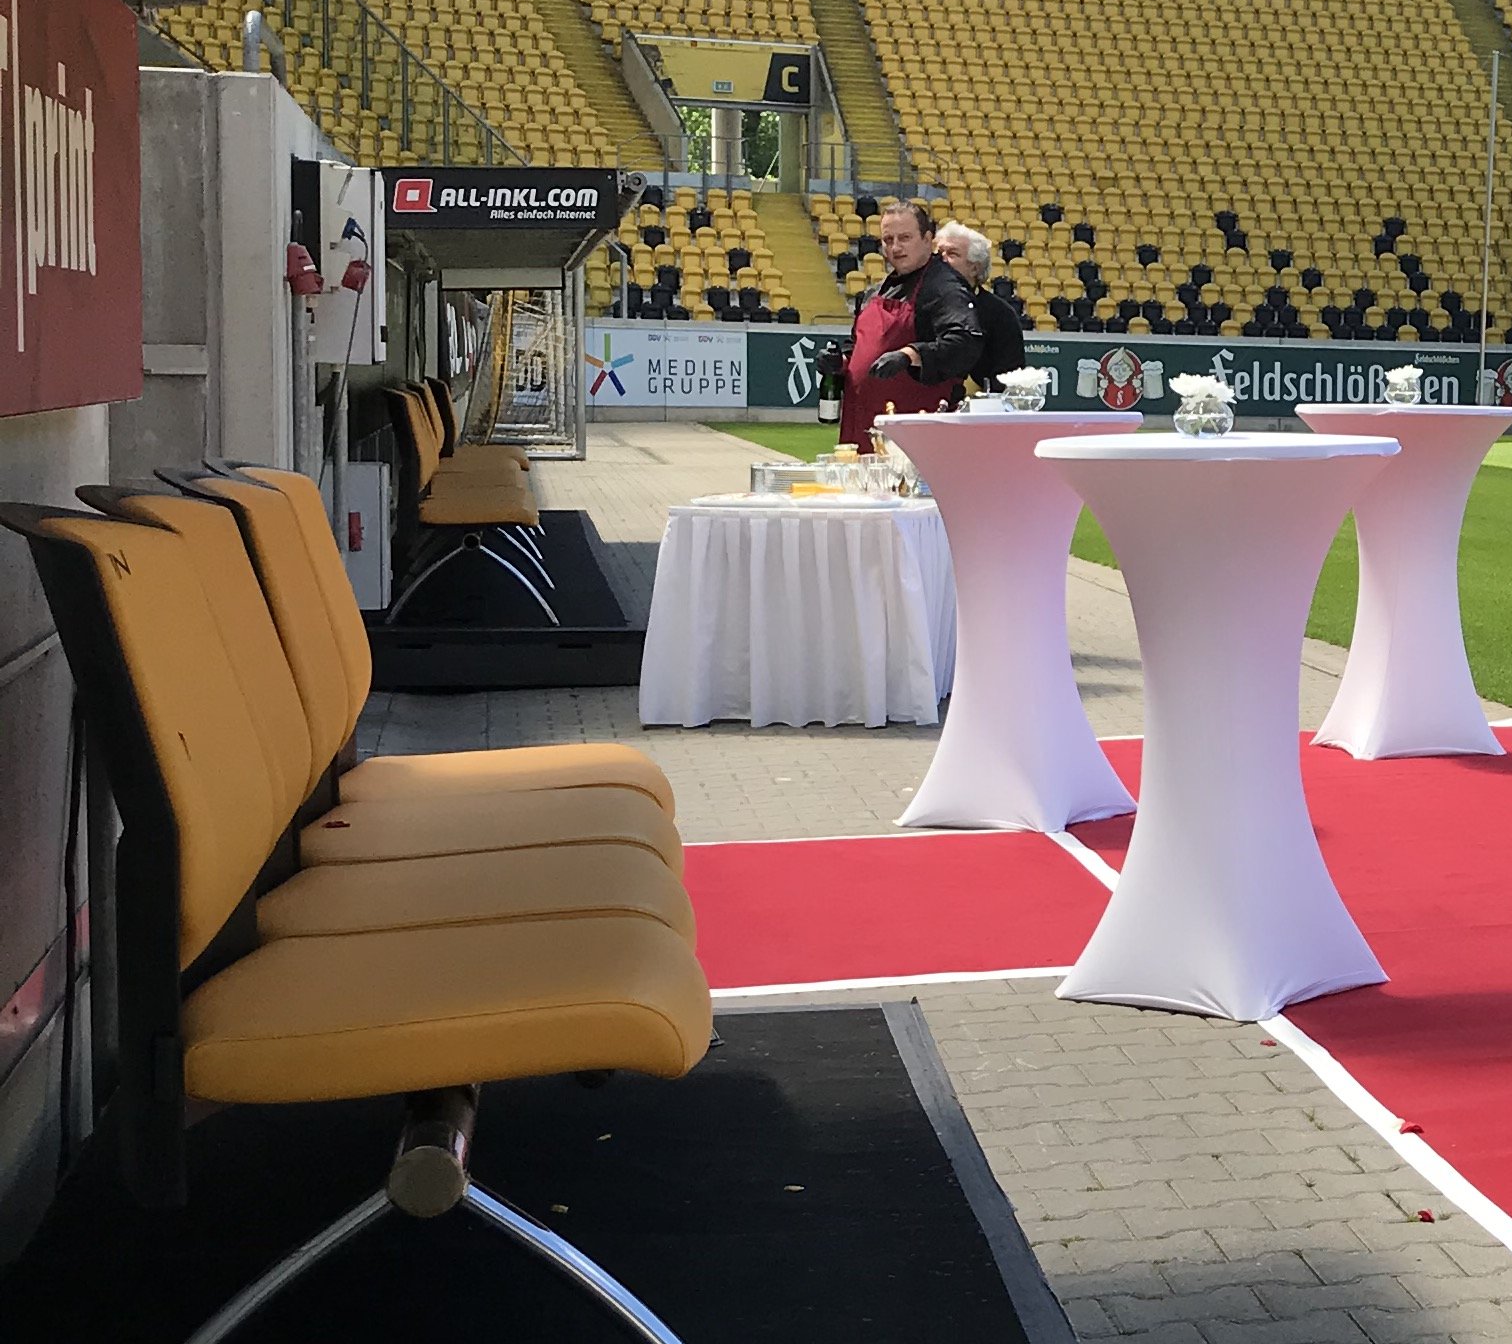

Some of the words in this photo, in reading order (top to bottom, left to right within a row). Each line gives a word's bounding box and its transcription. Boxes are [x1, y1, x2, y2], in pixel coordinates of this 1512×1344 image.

[781, 65, 799, 93] C
[25, 61, 97, 295] print
[440, 188, 598, 207] ALL-INKL.COM
[490, 209, 515, 219] Alles
[556, 209, 596, 219] Internet
[648, 358, 742, 377] MEDIEN
[648, 377, 742, 395] GRUPPE
